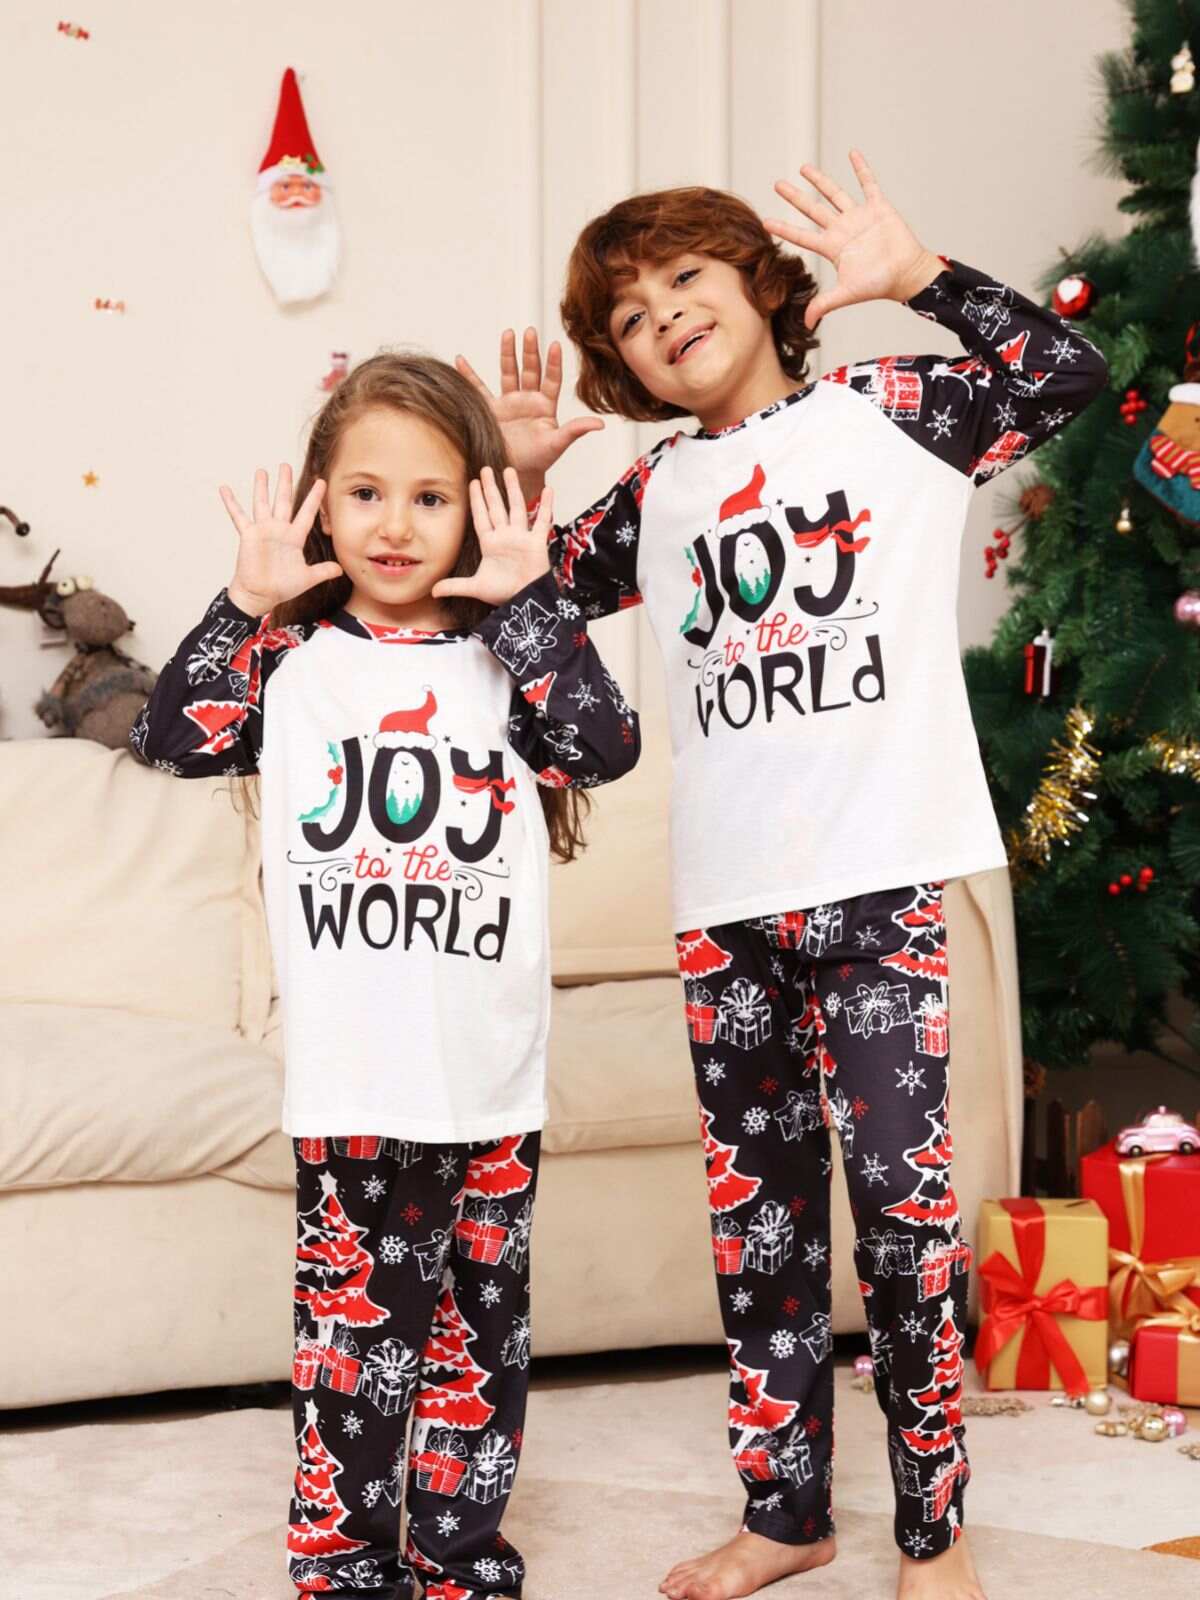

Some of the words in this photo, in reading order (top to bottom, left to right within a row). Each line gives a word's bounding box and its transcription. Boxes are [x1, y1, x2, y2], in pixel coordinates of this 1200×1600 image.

[723, 636, 745, 667] to
[755, 612, 809, 652] the
[354, 847, 392, 879] to
[402, 845, 453, 882] the
